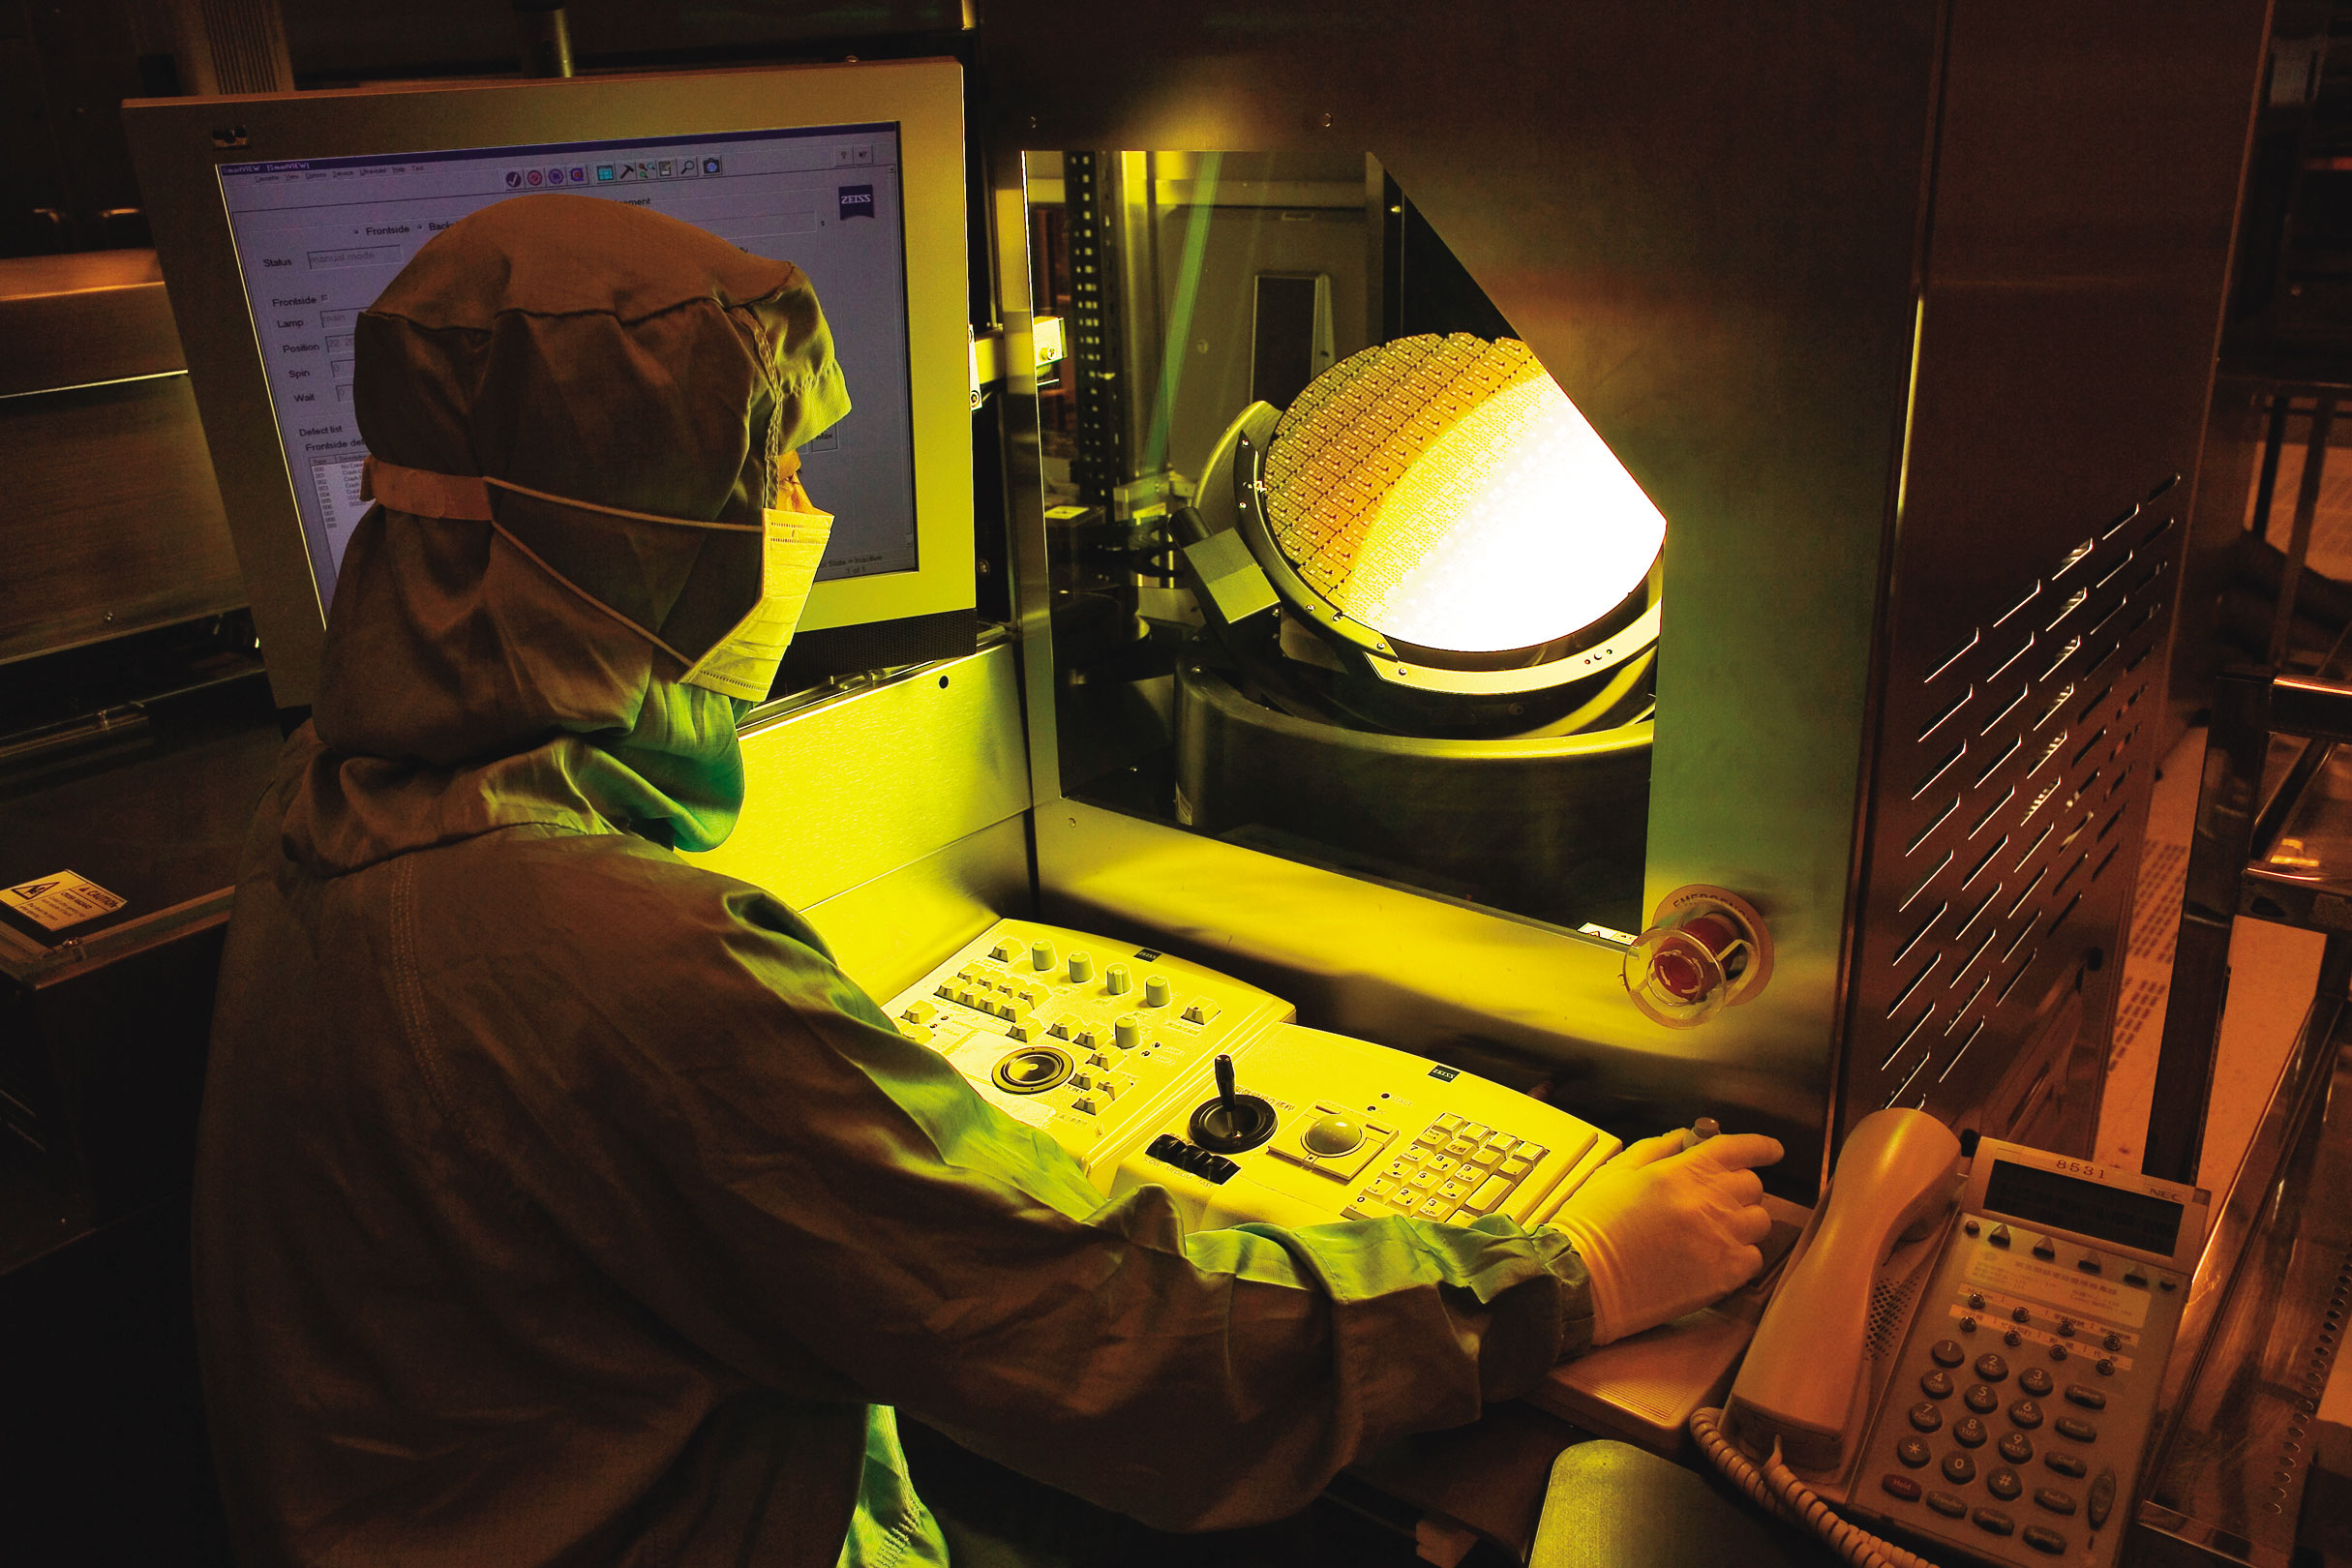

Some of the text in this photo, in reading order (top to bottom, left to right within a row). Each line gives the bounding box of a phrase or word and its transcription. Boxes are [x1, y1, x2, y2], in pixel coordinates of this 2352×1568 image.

[841, 194, 871, 204] ZEISS
[366, 225, 410, 236] Frontside
[262, 257, 292, 268] Status
[272, 295, 317, 308] Frontside
[277, 318, 304, 329] Lamp
[282, 344, 320, 353] Position
[288, 369, 311, 379] Spin
[293, 393, 316, 403] Wait
[299, 425, 343, 437] Defect list
[305, 441, 347, 452] Frontside
[855, 556, 883, 564] Inactive
[86, 890, 119, 908] CAUTION
[1432, 1069, 1455, 1079] ZEISS
[1142, 1157, 1214, 1189] SLOW MEDIUM FAST
[2056, 1159, 2106, 1179] 8531
[2149, 1188, 2184, 1201] NEC
[1947, 1342, 1952, 1351] 1
[1988, 1355, 1998, 1366] 2
[1981, 1364, 1999, 1372] ABC
[1934, 1372, 1944, 1382] 4
[2034, 1370, 2042, 1380] 3
[1977, 1386, 1988, 1397] 5
[1922, 1403, 1934, 1413] 7
[2022, 1402, 2032, 1411] 6
[2015, 1408, 2036, 1420] MNO
[1968, 1419, 1976, 1430] 8
[1961, 1427, 1978, 1437] TUV
[2013, 1433, 2023, 1444] 9
[1954, 1458, 1964, 1469] 0
[2058, 1455, 2076, 1465] Conf
[1893, 1479, 1912, 1491] Hold
[1998, 1475, 2012, 1487] #
